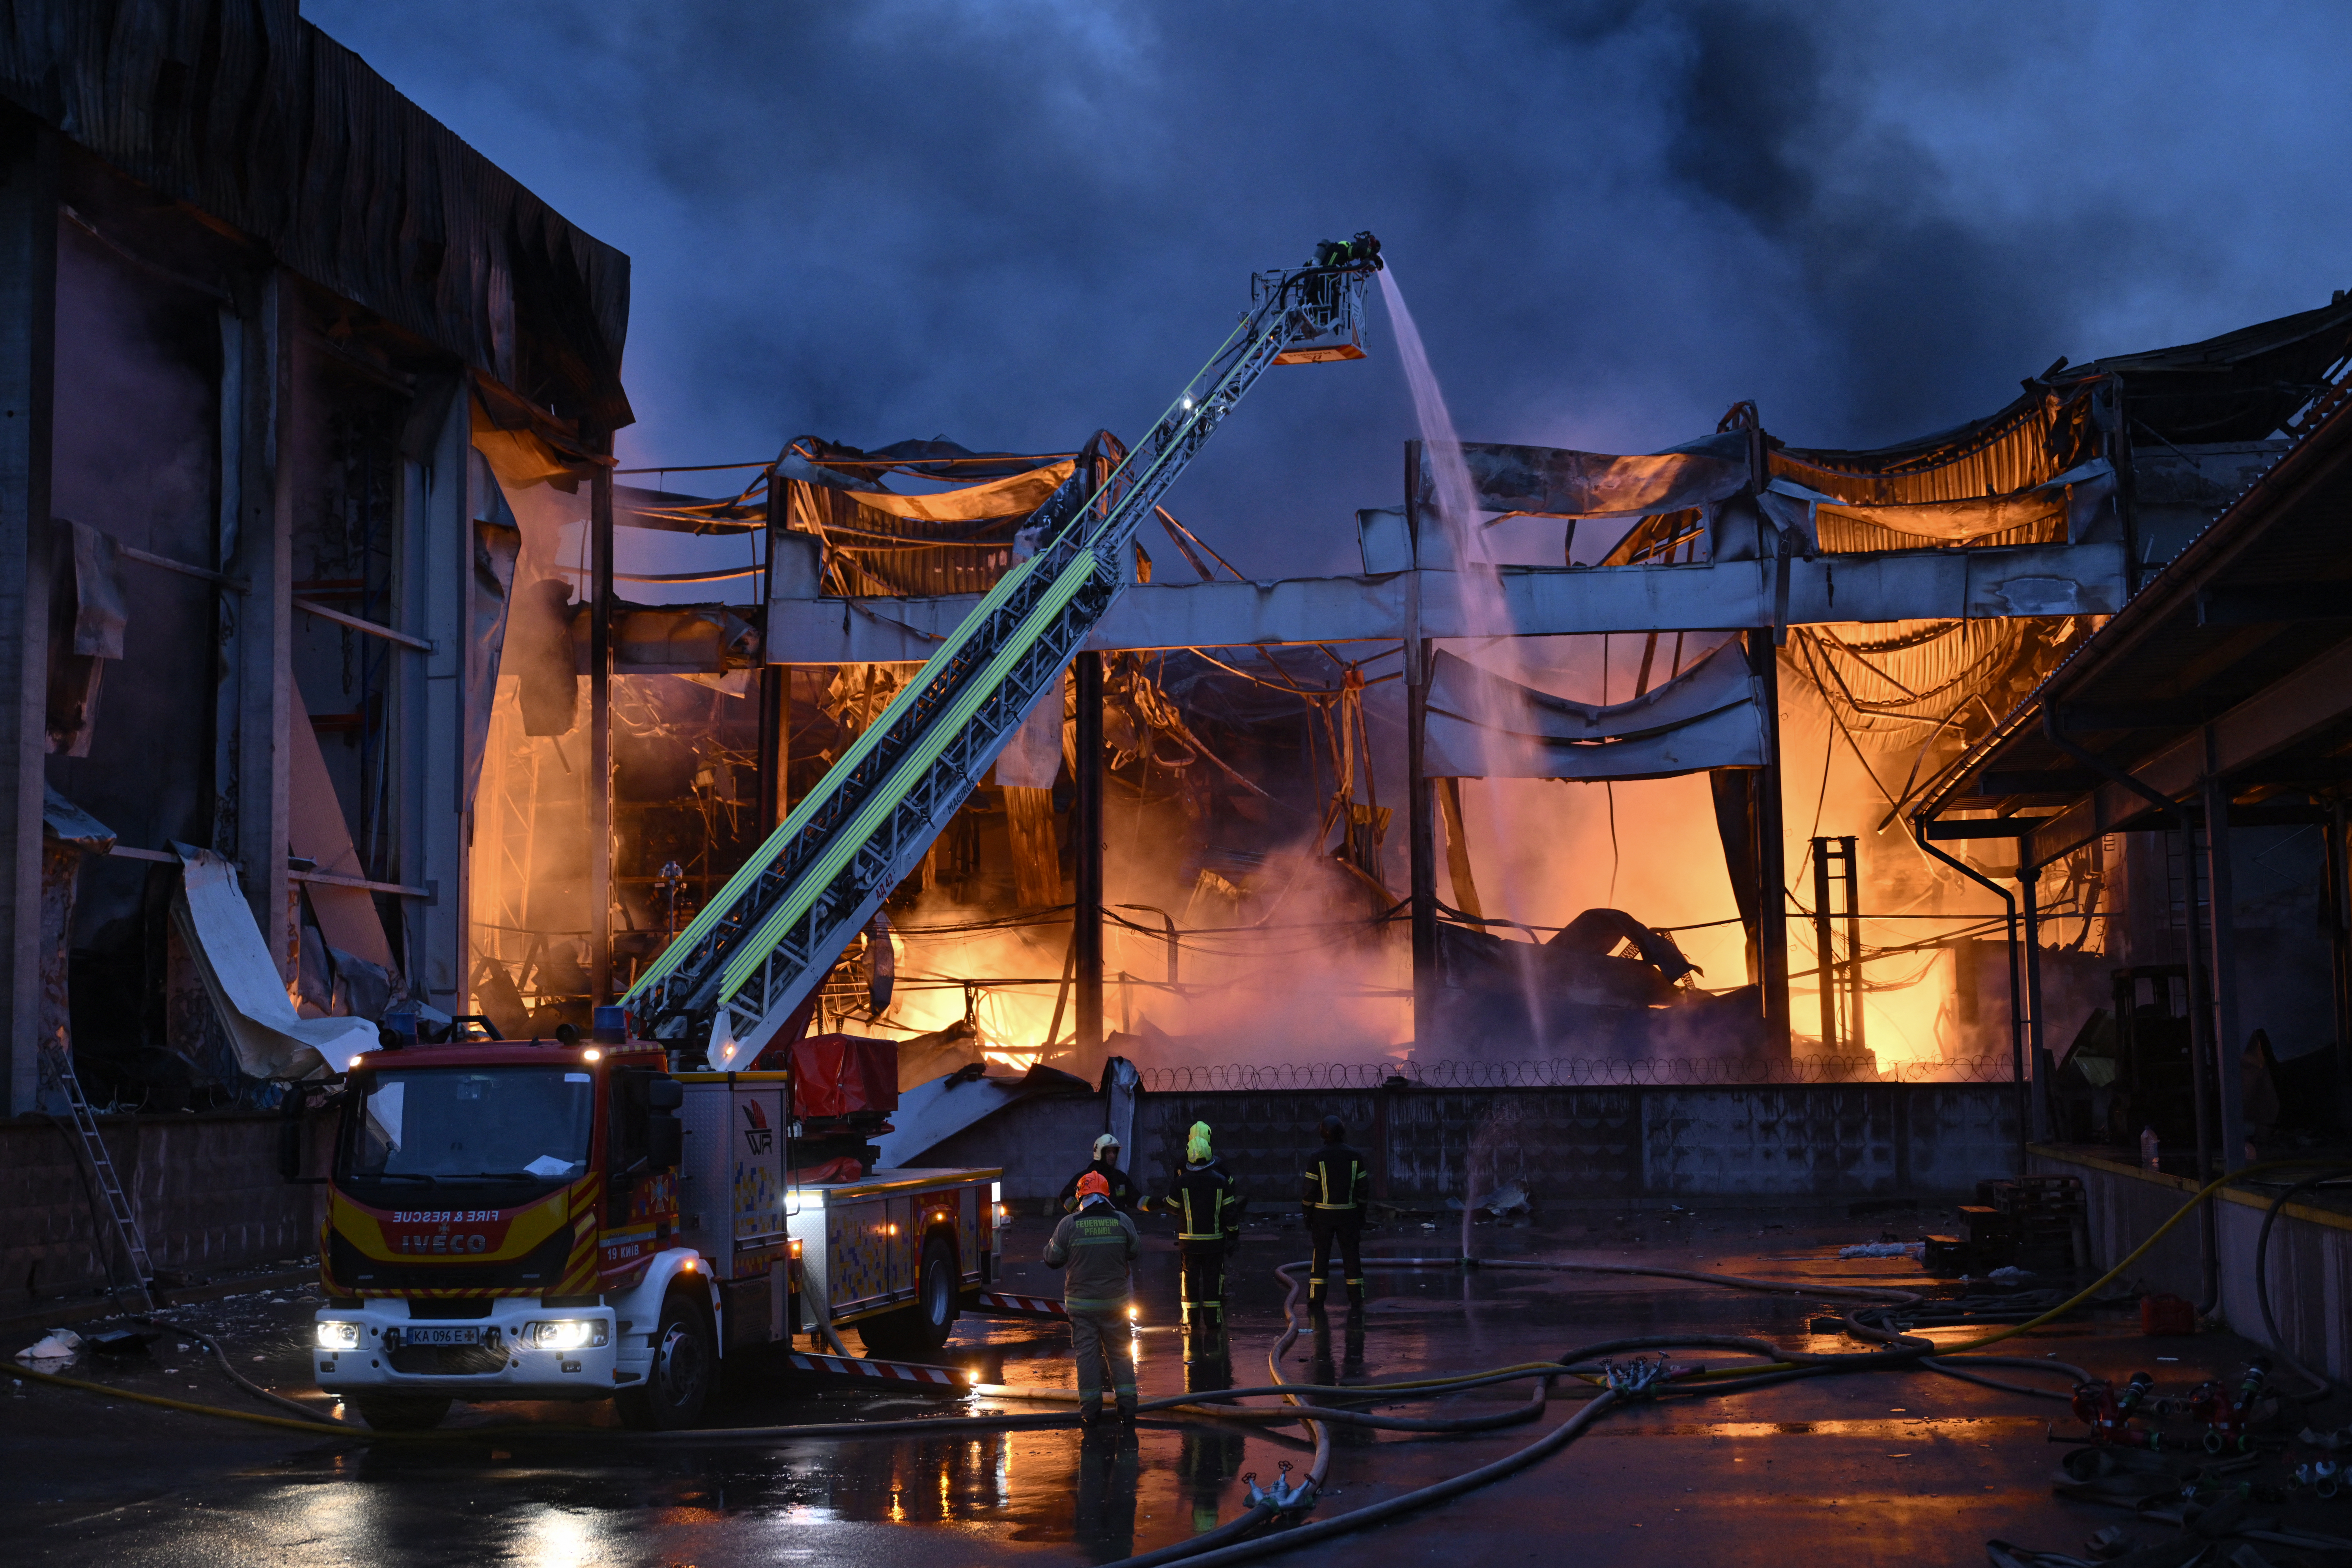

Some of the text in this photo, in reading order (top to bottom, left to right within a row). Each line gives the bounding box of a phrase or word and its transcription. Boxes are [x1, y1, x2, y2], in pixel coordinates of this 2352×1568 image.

[947, 776, 975, 815] MAGIRUS
[886, 873, 894, 888] 42
[1076, 1219, 1119, 1229] FEUERWEHR
[1084, 1227, 1112, 1235] PFANDL
[402, 1235, 486, 1254] IVECO
[607, 1243, 639, 1261] 19 КИЇВ
[433, 1330, 451, 1342] 096
[455, 1330, 462, 1342] E
